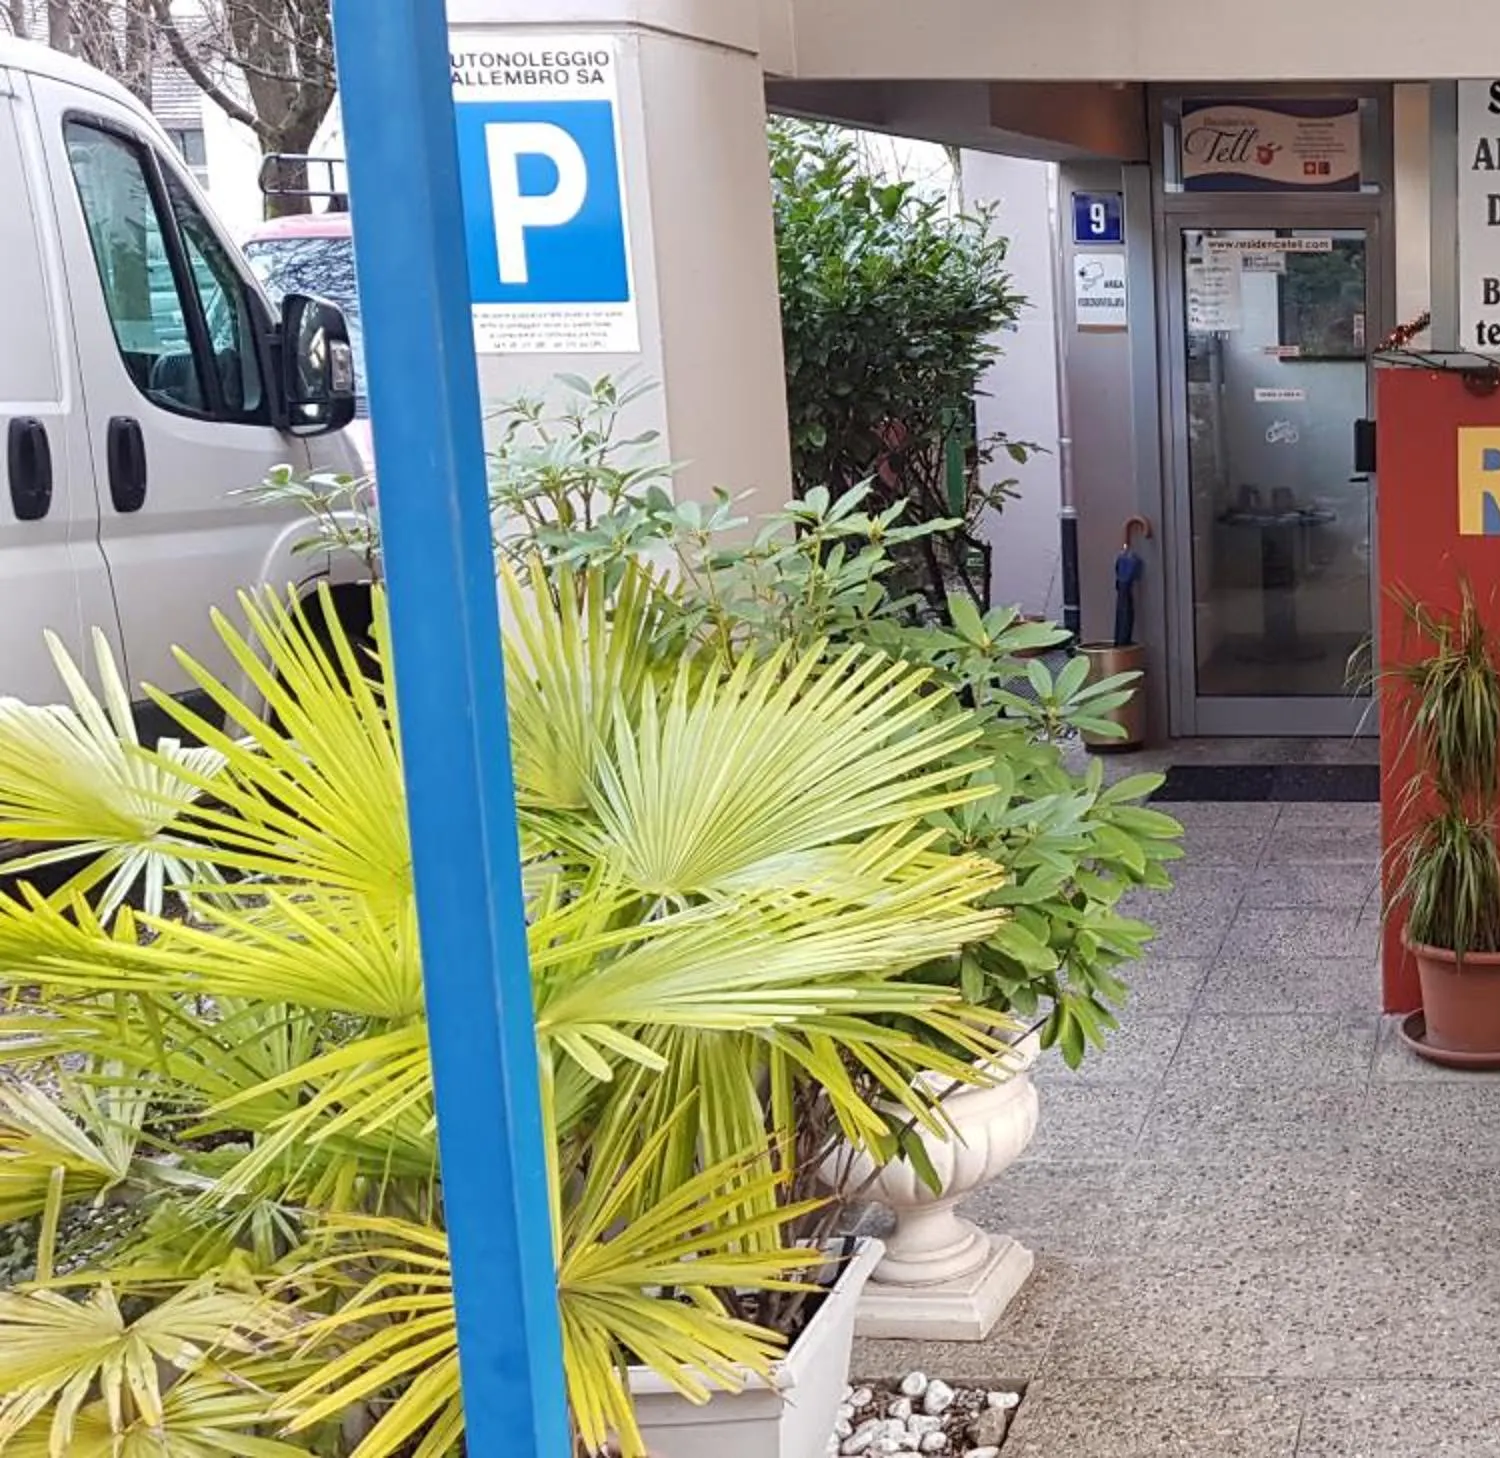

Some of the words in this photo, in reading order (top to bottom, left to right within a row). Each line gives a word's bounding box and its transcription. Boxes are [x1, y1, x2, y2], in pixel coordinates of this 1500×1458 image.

[450, 51, 609, 68] UTONOLEGGIO
[450, 70, 569, 86] ALLEMBRO
[576, 69, 604, 85] SA
[1184, 126, 1259, 163] Tell
[484, 121, 588, 284] P
[1090, 203, 1106, 234] 9
